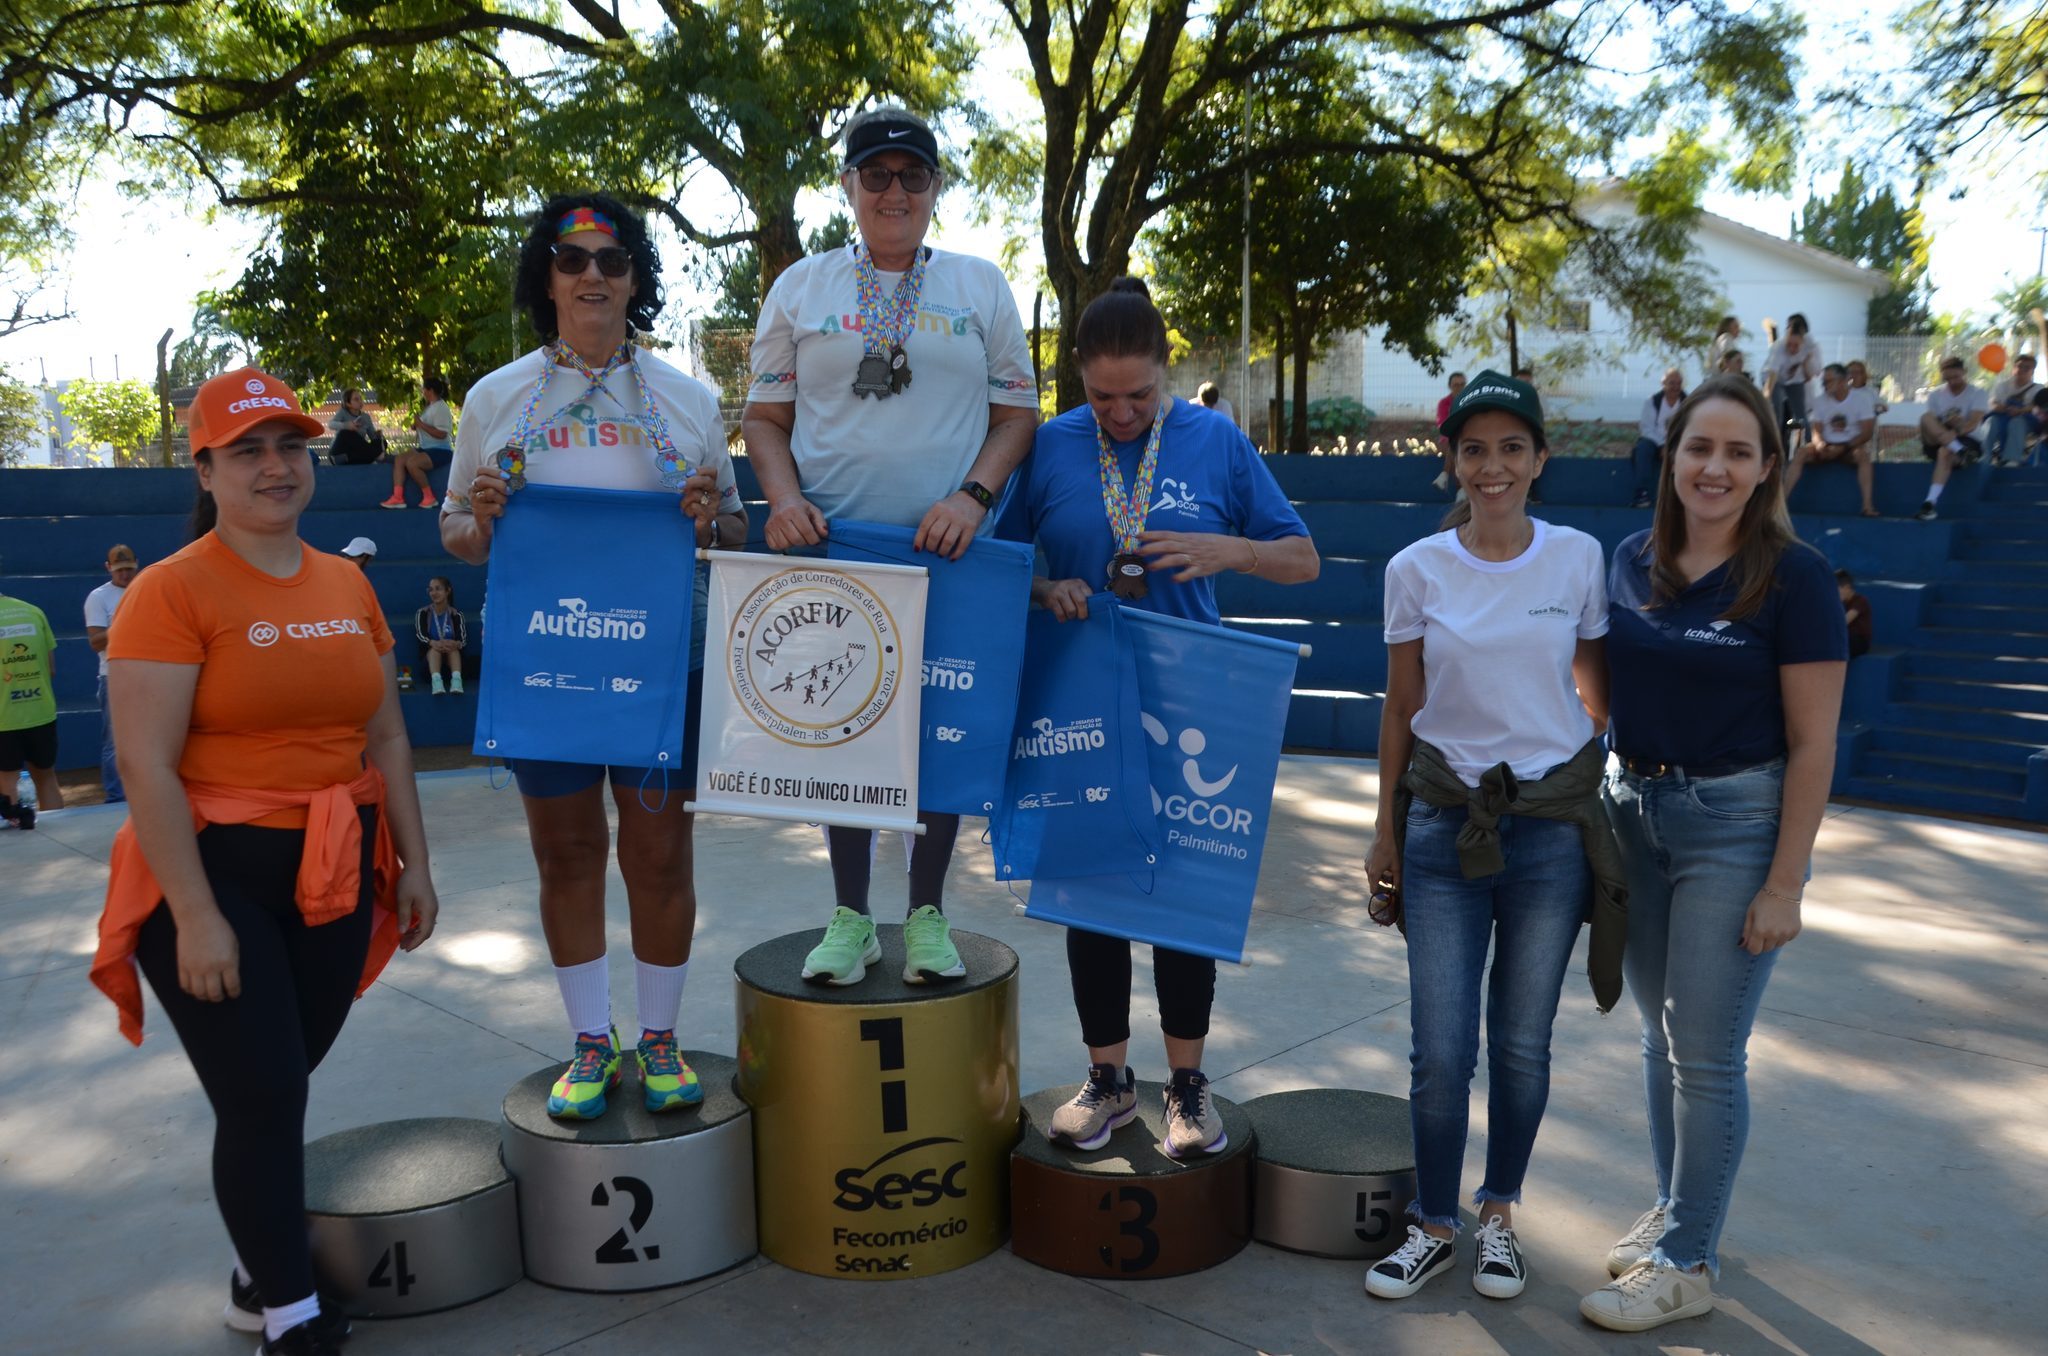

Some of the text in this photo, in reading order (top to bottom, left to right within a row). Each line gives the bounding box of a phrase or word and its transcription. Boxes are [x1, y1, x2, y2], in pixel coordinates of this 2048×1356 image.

[820, 311, 968, 337] Aumo
[228, 397, 292, 414] CRESOL
[1481, 385, 1521, 400] Branca
[527, 421, 654, 454] Autism
[1176, 500, 1200, 512] GCOR
[742, 571, 888, 634] Associação de Corredores de Rua
[286, 618, 365, 639] CRESOL
[527, 610, 646, 641] Autismo
[755, 602, 853, 668] ACORFW
[734, 646, 752, 700] Frederico
[921, 660, 966, 670] ONSCIENTIZAÇÃO
[856, 669, 896, 727] Desde 2024
[1014, 729, 1105, 760] Autismo
[709, 771, 907, 807] VOCÊ É O SEU ÚNICO LIMITE!
[1164, 794, 1253, 836] GCOR
[1167, 829, 1248, 860] Palmitinho
[859, 1017, 908, 1134] 1
[832, 1150, 968, 1212] Sesc
[591, 1176, 660, 1264] 2
[833, 1217, 968, 1248] Fecomércio
[1099, 1186, 1160, 1273] 3
[1354, 1190, 1392, 1243] 5
[367, 1240, 417, 1297] 4
[835, 1254, 911, 1274] Senac
